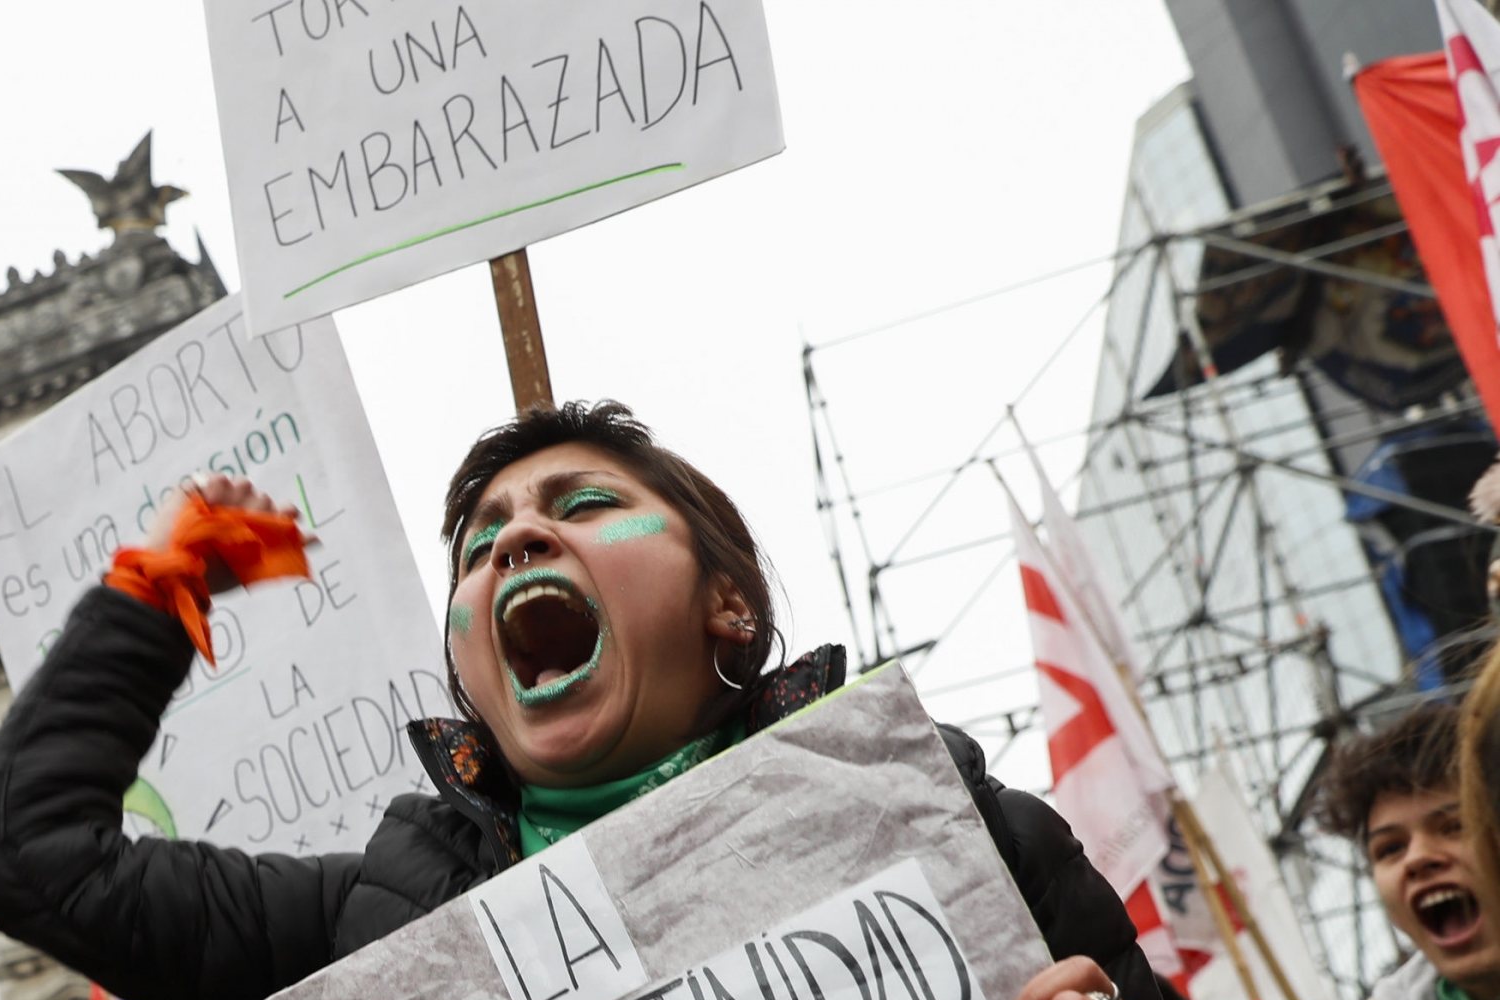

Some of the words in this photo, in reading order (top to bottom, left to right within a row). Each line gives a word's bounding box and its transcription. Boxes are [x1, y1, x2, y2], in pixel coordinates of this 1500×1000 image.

[263, 5, 743, 247] EMBARAZADA
[274, 87, 305, 144] A
[368, 5, 488, 95] UNA
[1, 562, 52, 619] es
[62, 513, 123, 583] una
[294, 560, 357, 628] DE
[259, 663, 315, 721] LA
